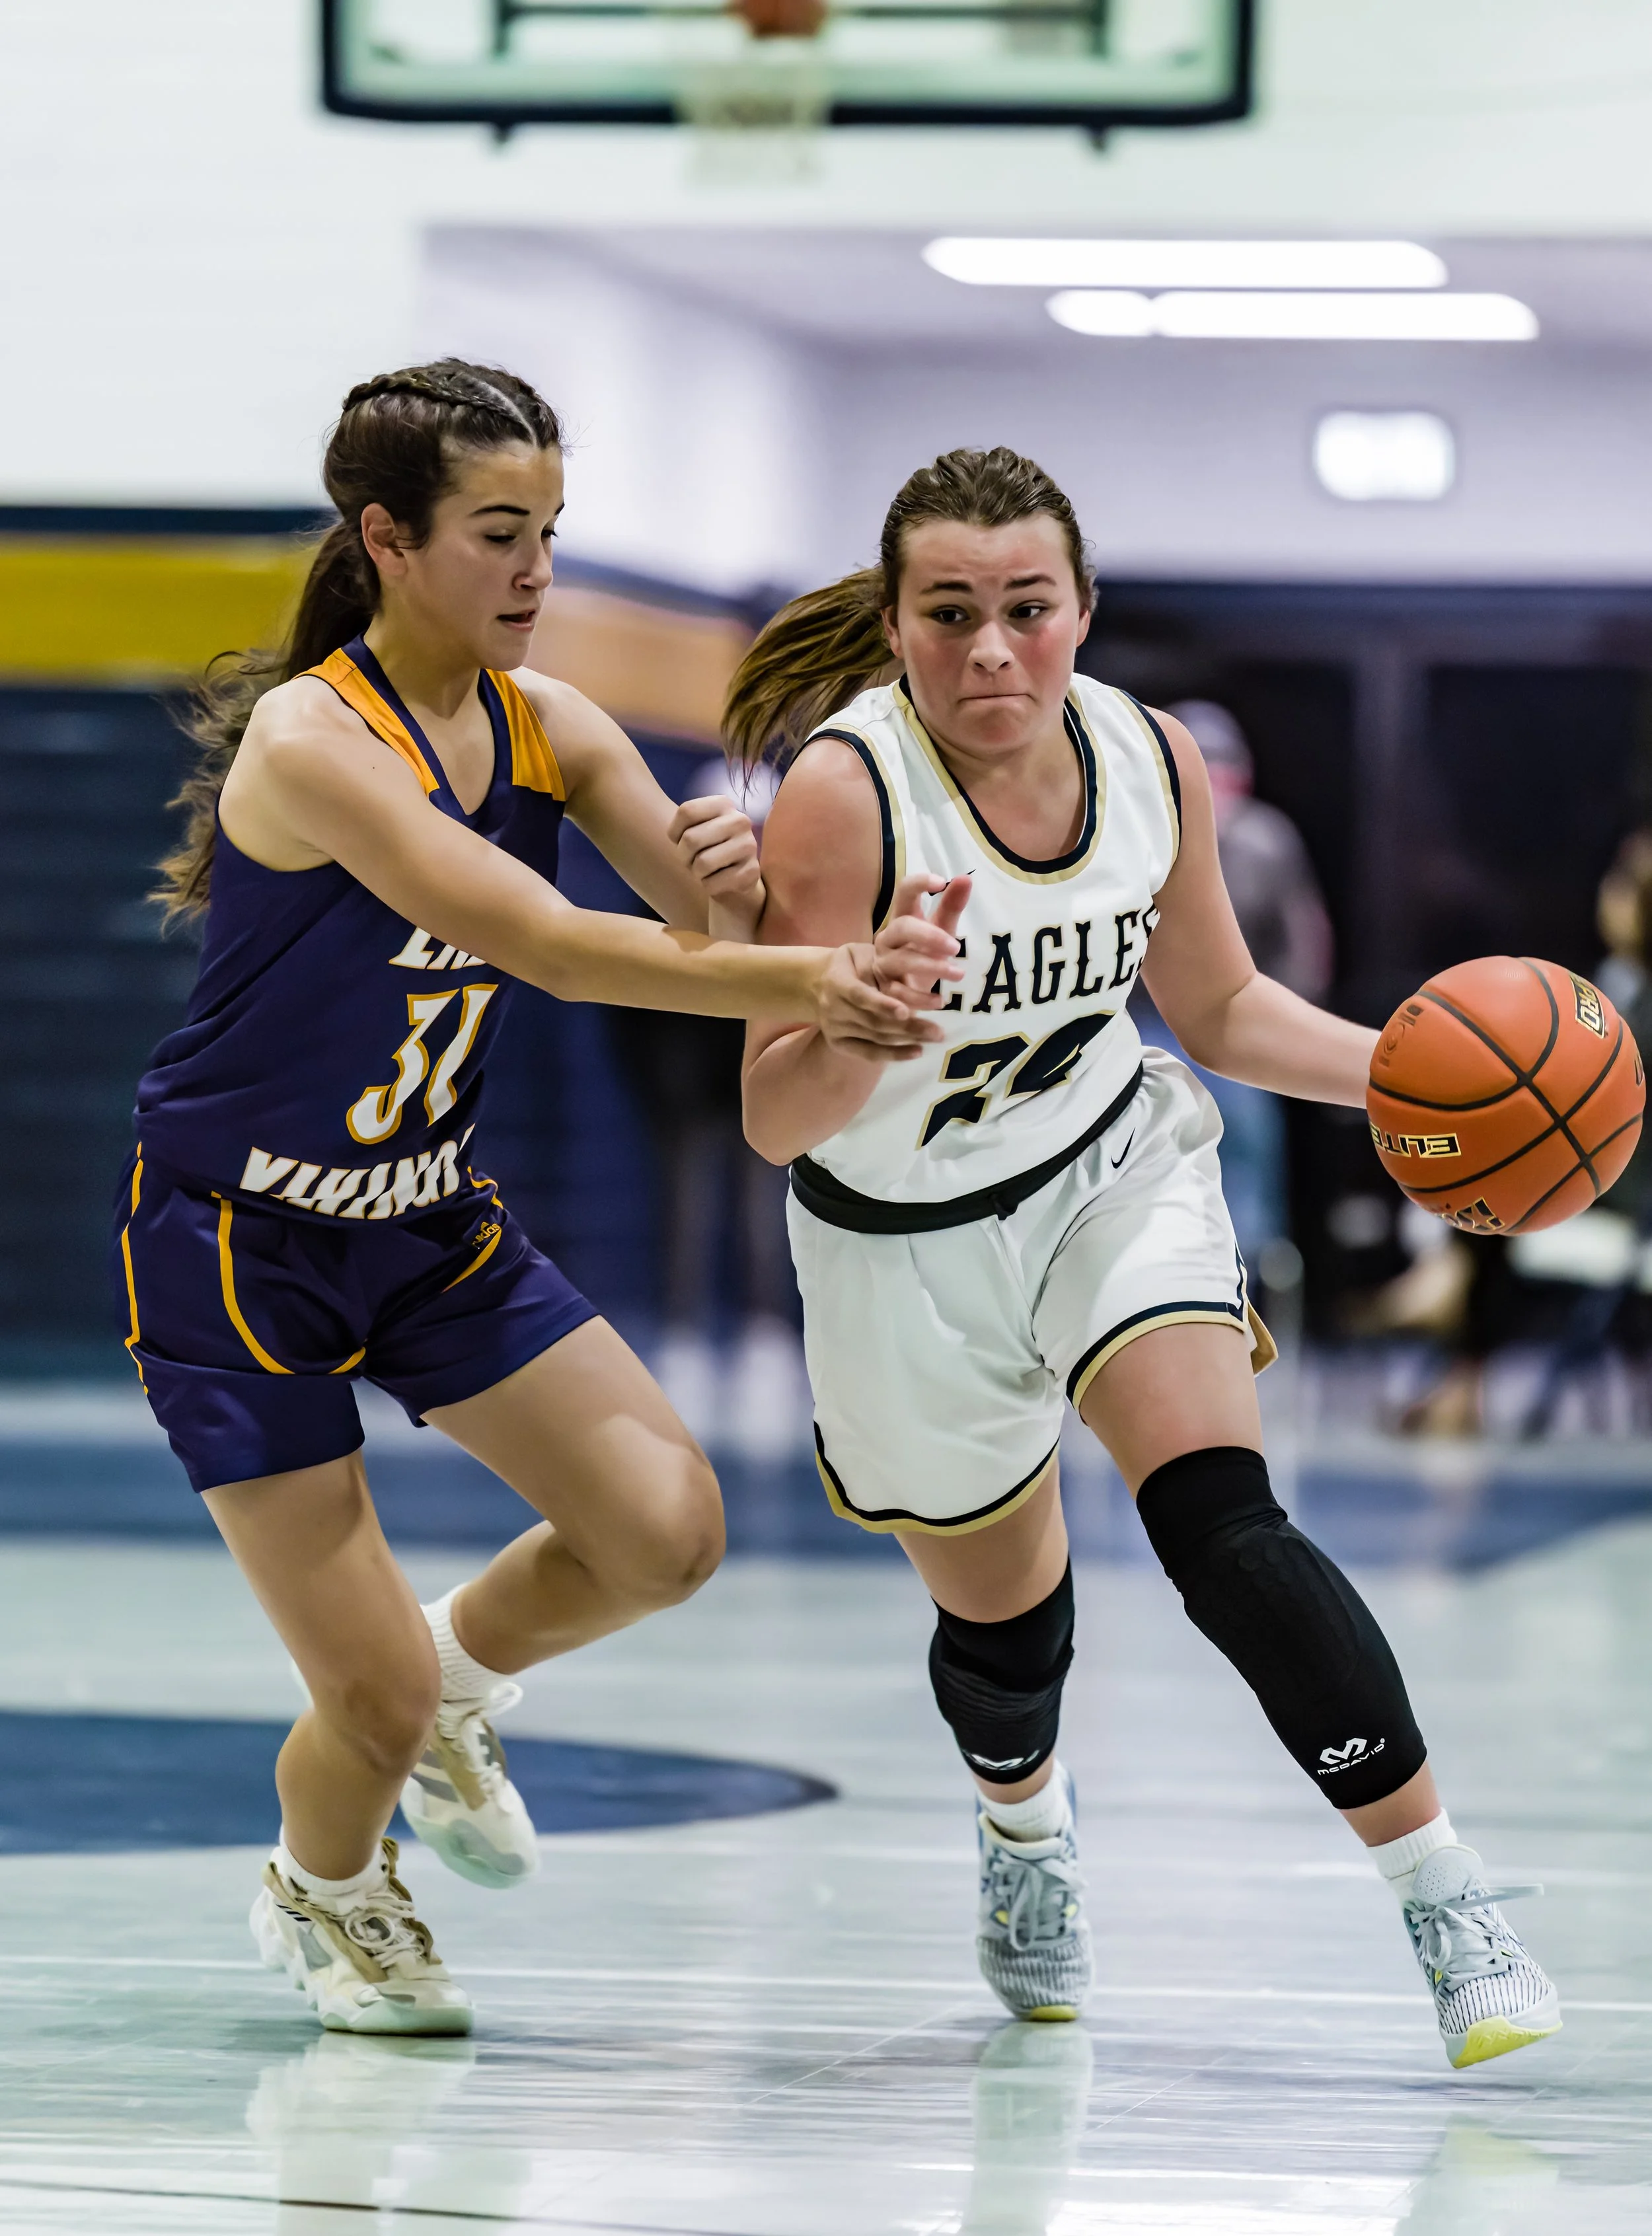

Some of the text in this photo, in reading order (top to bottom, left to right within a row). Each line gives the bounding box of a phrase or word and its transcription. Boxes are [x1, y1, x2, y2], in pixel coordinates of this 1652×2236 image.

[1574, 977, 1603, 1035] PRO
[346, 983, 499, 1144] 31
[915, 1009, 1117, 1151] 24
[239, 1123, 476, 1220] VIKING
[1370, 1121, 1462, 1158] ELITE
